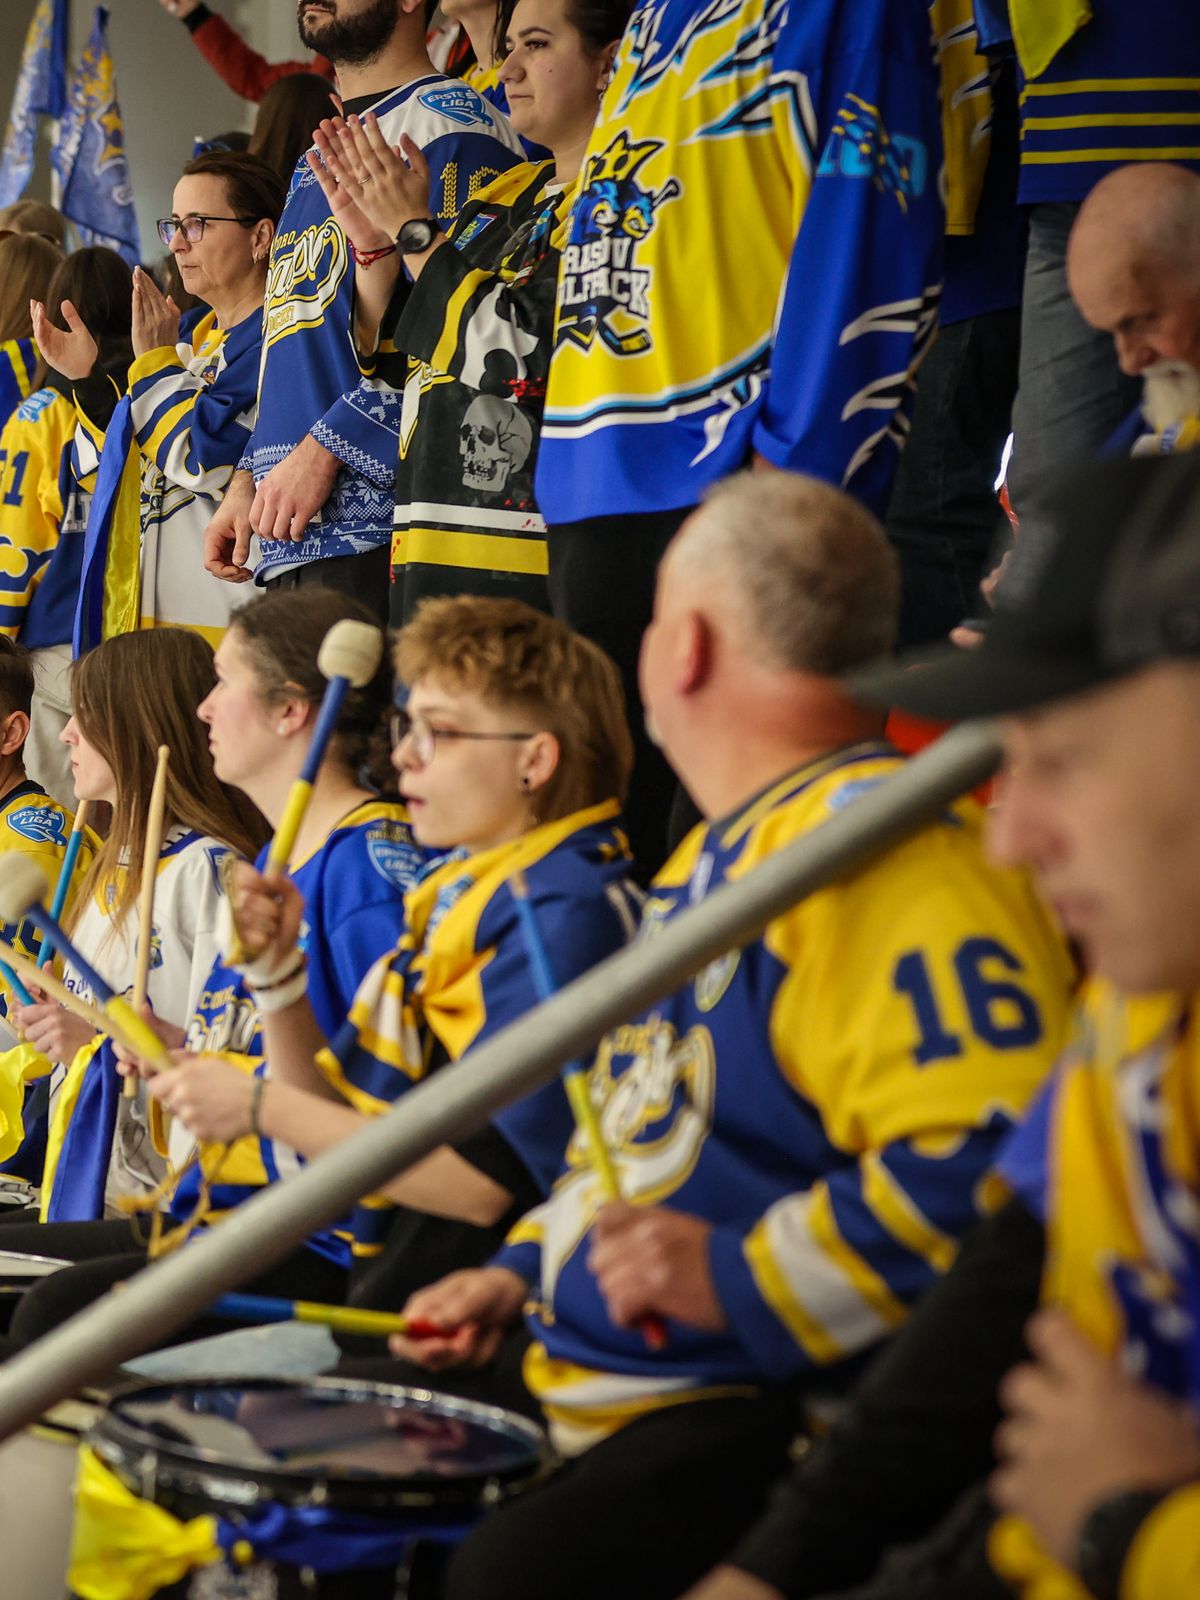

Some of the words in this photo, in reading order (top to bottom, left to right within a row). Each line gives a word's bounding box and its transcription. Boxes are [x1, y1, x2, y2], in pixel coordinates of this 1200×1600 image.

[427, 91, 465, 103] ERSTE
[441, 99, 474, 108] LIGA
[13, 810, 47, 821] ERSTE
[20, 816, 53, 826] LIGA
[894, 937, 1042, 1066] 16
